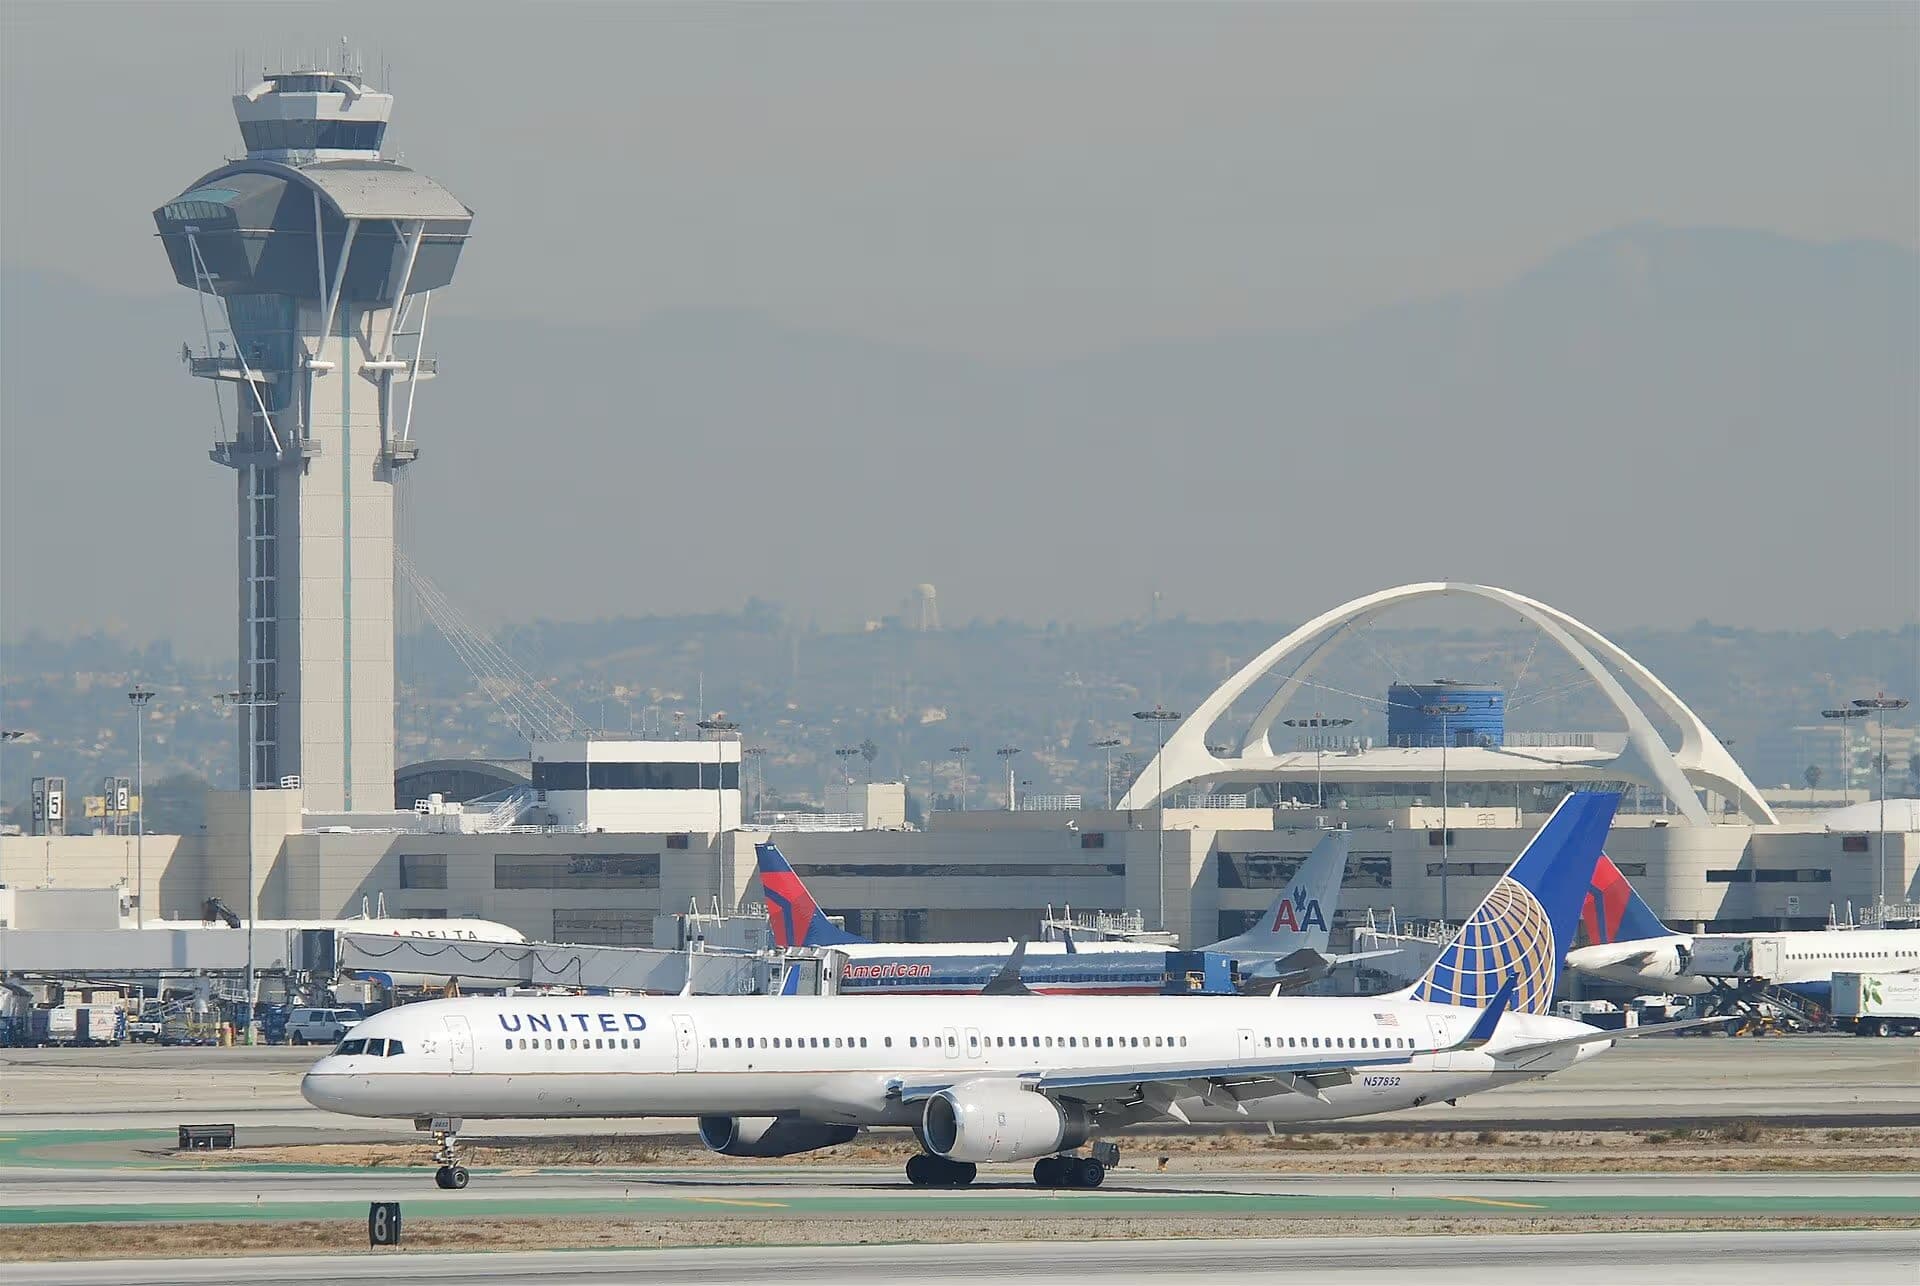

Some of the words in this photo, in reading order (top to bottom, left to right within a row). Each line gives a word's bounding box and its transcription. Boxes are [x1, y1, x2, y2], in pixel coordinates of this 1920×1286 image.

[51, 796, 60, 815] 5
[119, 792, 126, 807] 2
[1272, 899, 1328, 932] AA
[842, 962, 931, 979] American
[498, 1013, 647, 1033] UNITED
[1363, 1075, 1401, 1087] N57852
[374, 1205, 387, 1242] 8
